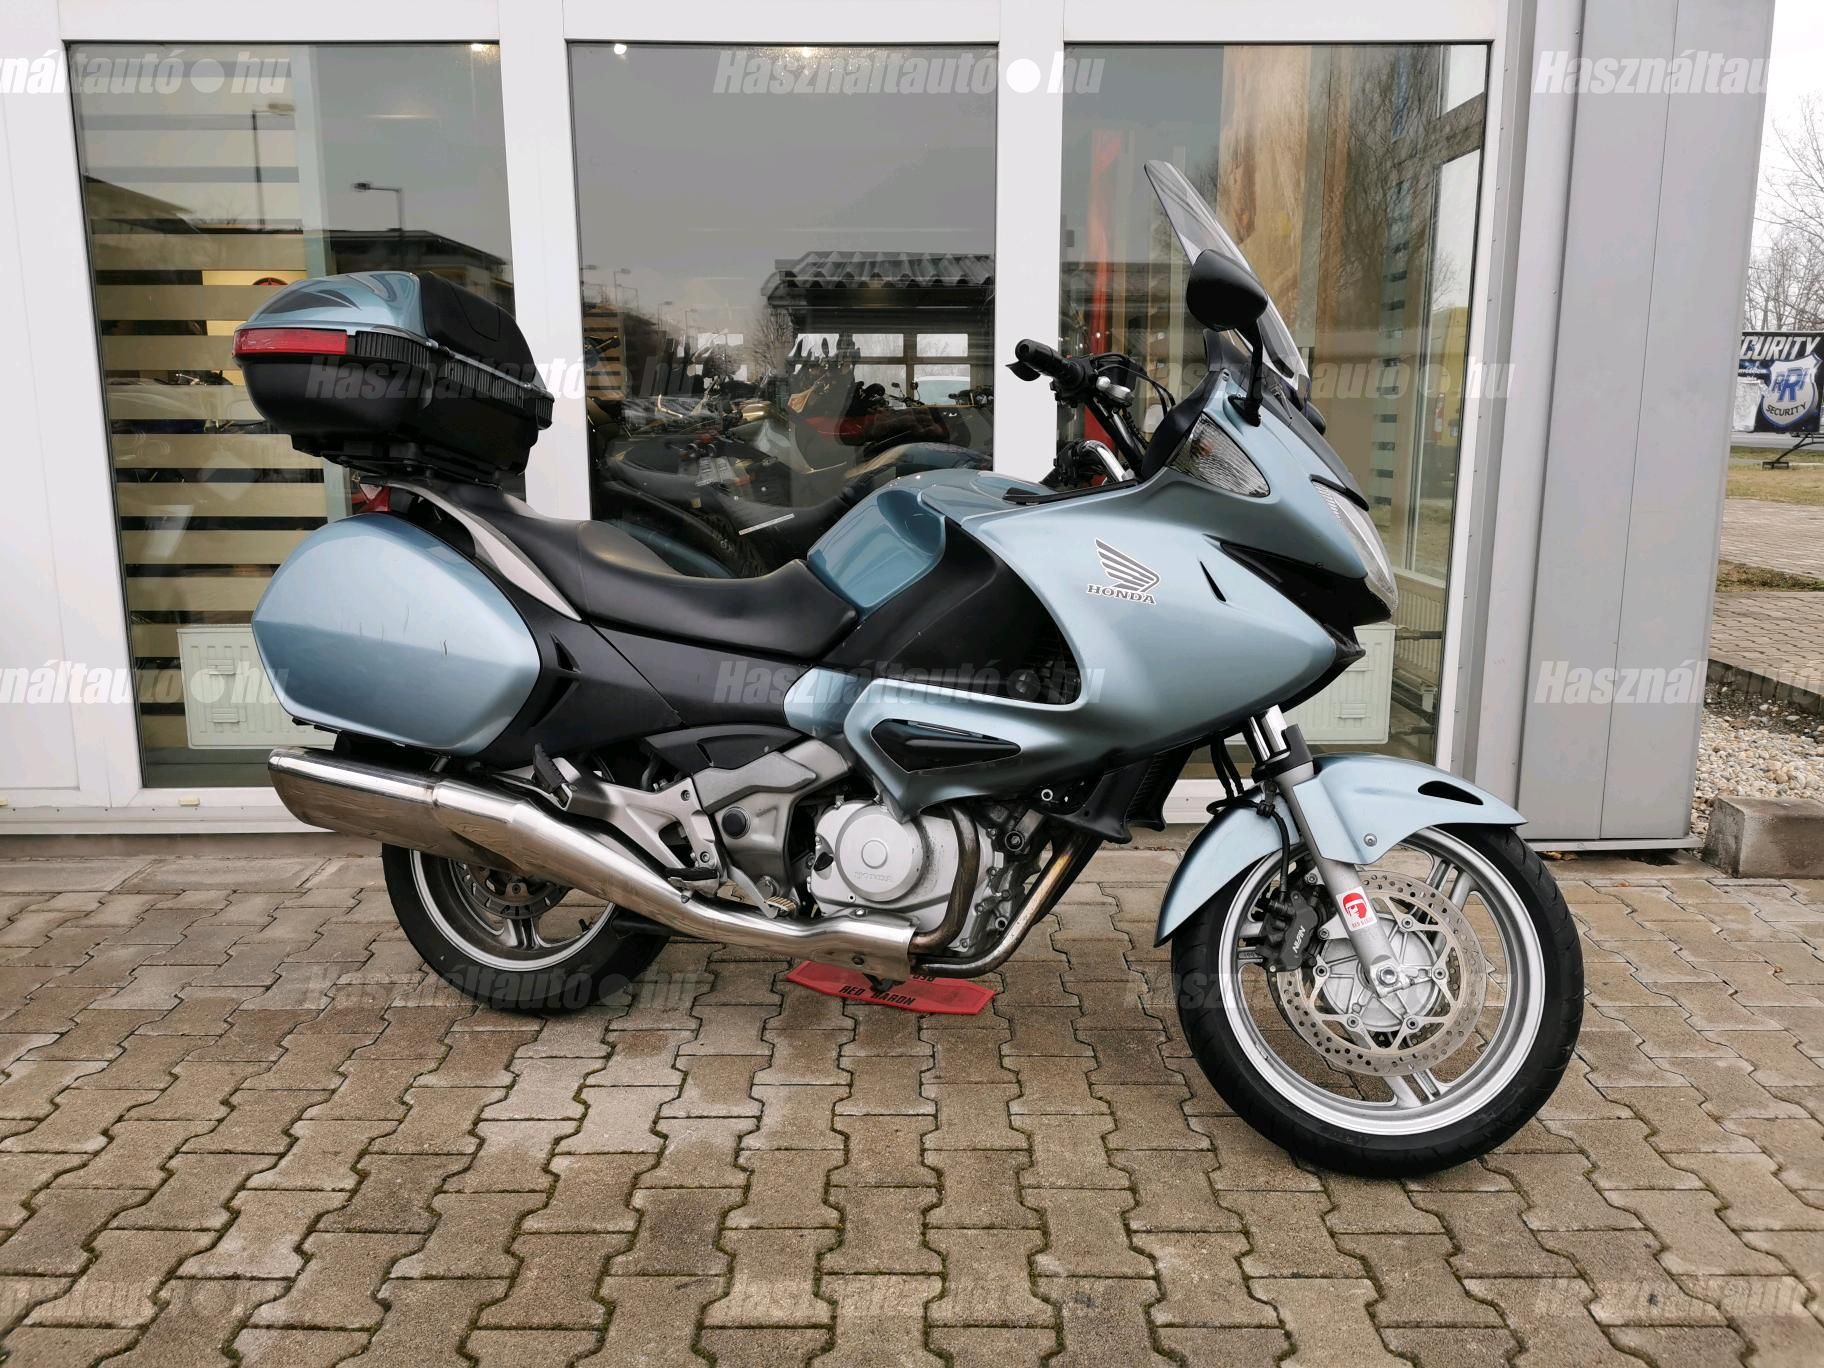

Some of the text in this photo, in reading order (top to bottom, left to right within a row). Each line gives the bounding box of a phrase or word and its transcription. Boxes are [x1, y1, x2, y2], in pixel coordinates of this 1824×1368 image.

[1740, 335, 1821, 360] CURITY
[1766, 401, 1806, 416] SECURITY
[1087, 585, 1156, 604] HONDA
[839, 985, 917, 1005] RED BARON
